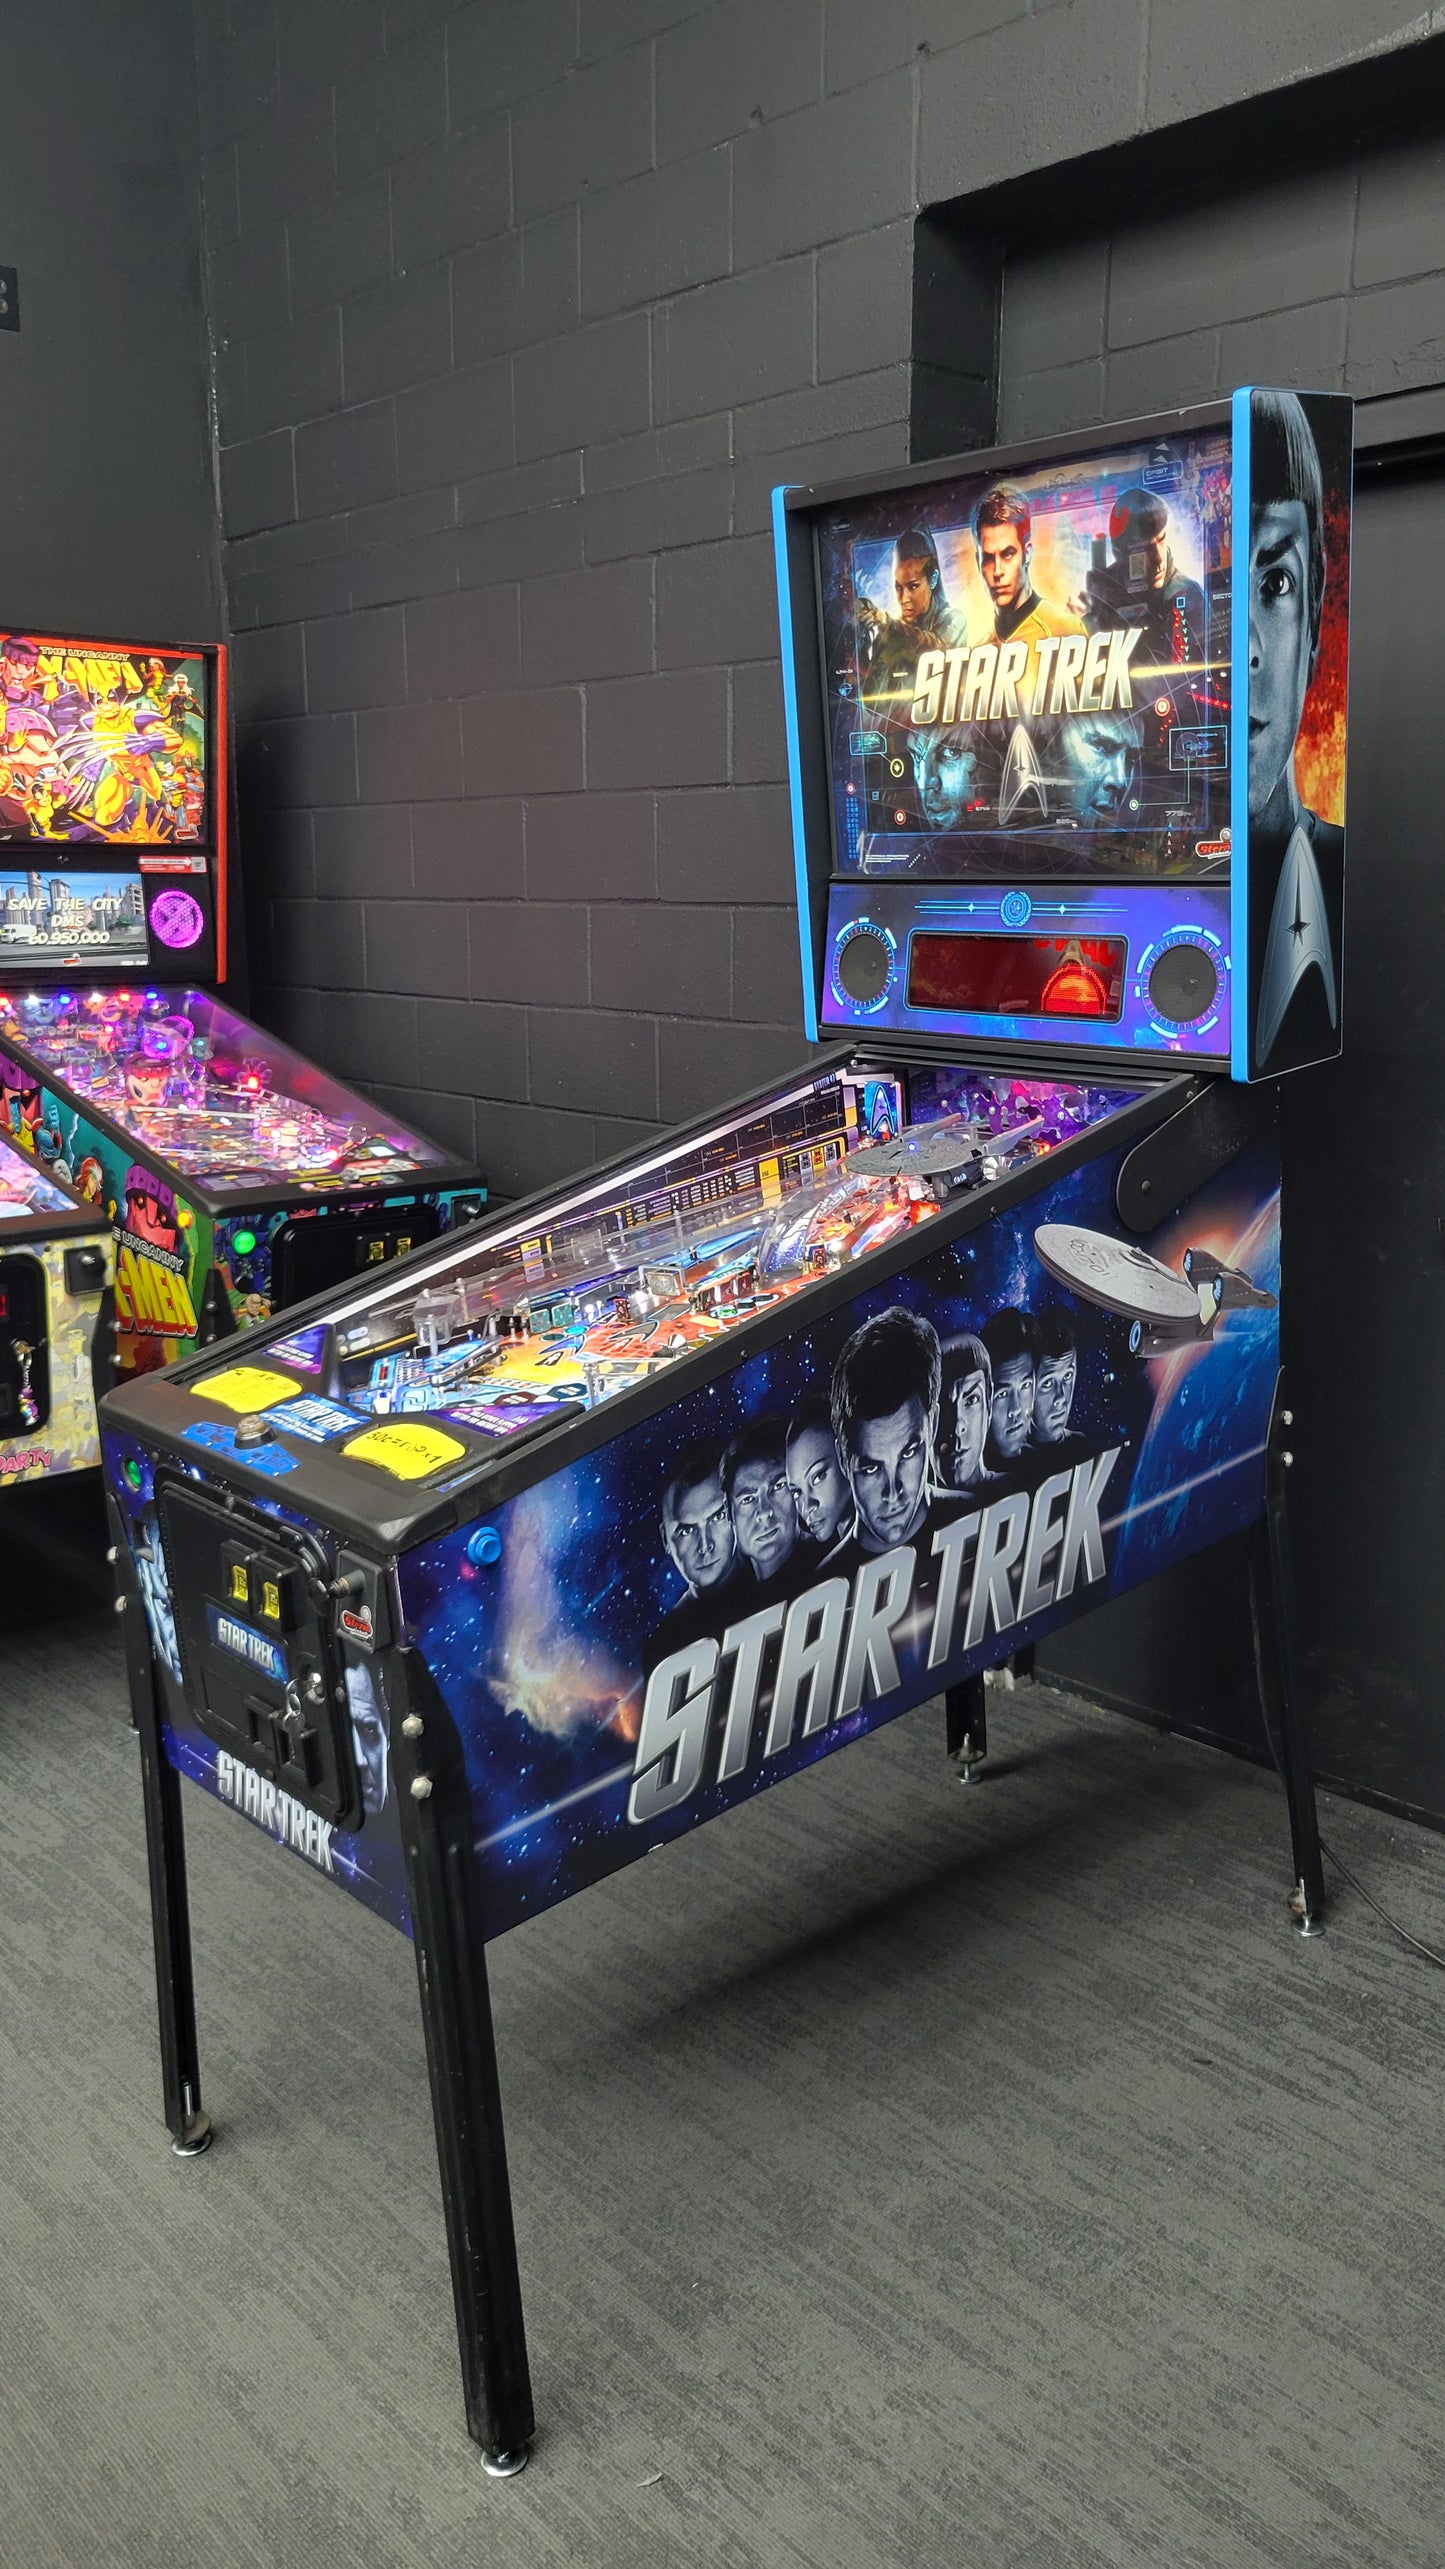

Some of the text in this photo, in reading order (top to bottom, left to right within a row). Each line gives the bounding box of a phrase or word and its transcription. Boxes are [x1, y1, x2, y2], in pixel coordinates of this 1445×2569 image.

[38, 645, 131, 661] THE UNCANNY
[910, 627, 1144, 725] STAR TREK
[7, 897, 124, 911] SAVE THE CITY
[121, 1230, 185, 1272] UNCANNY
[217, 1617, 276, 1672] STAR TREK
[627, 1446, 1122, 1826] STAR TREK
[216, 1749, 335, 1874] STAR TREK
